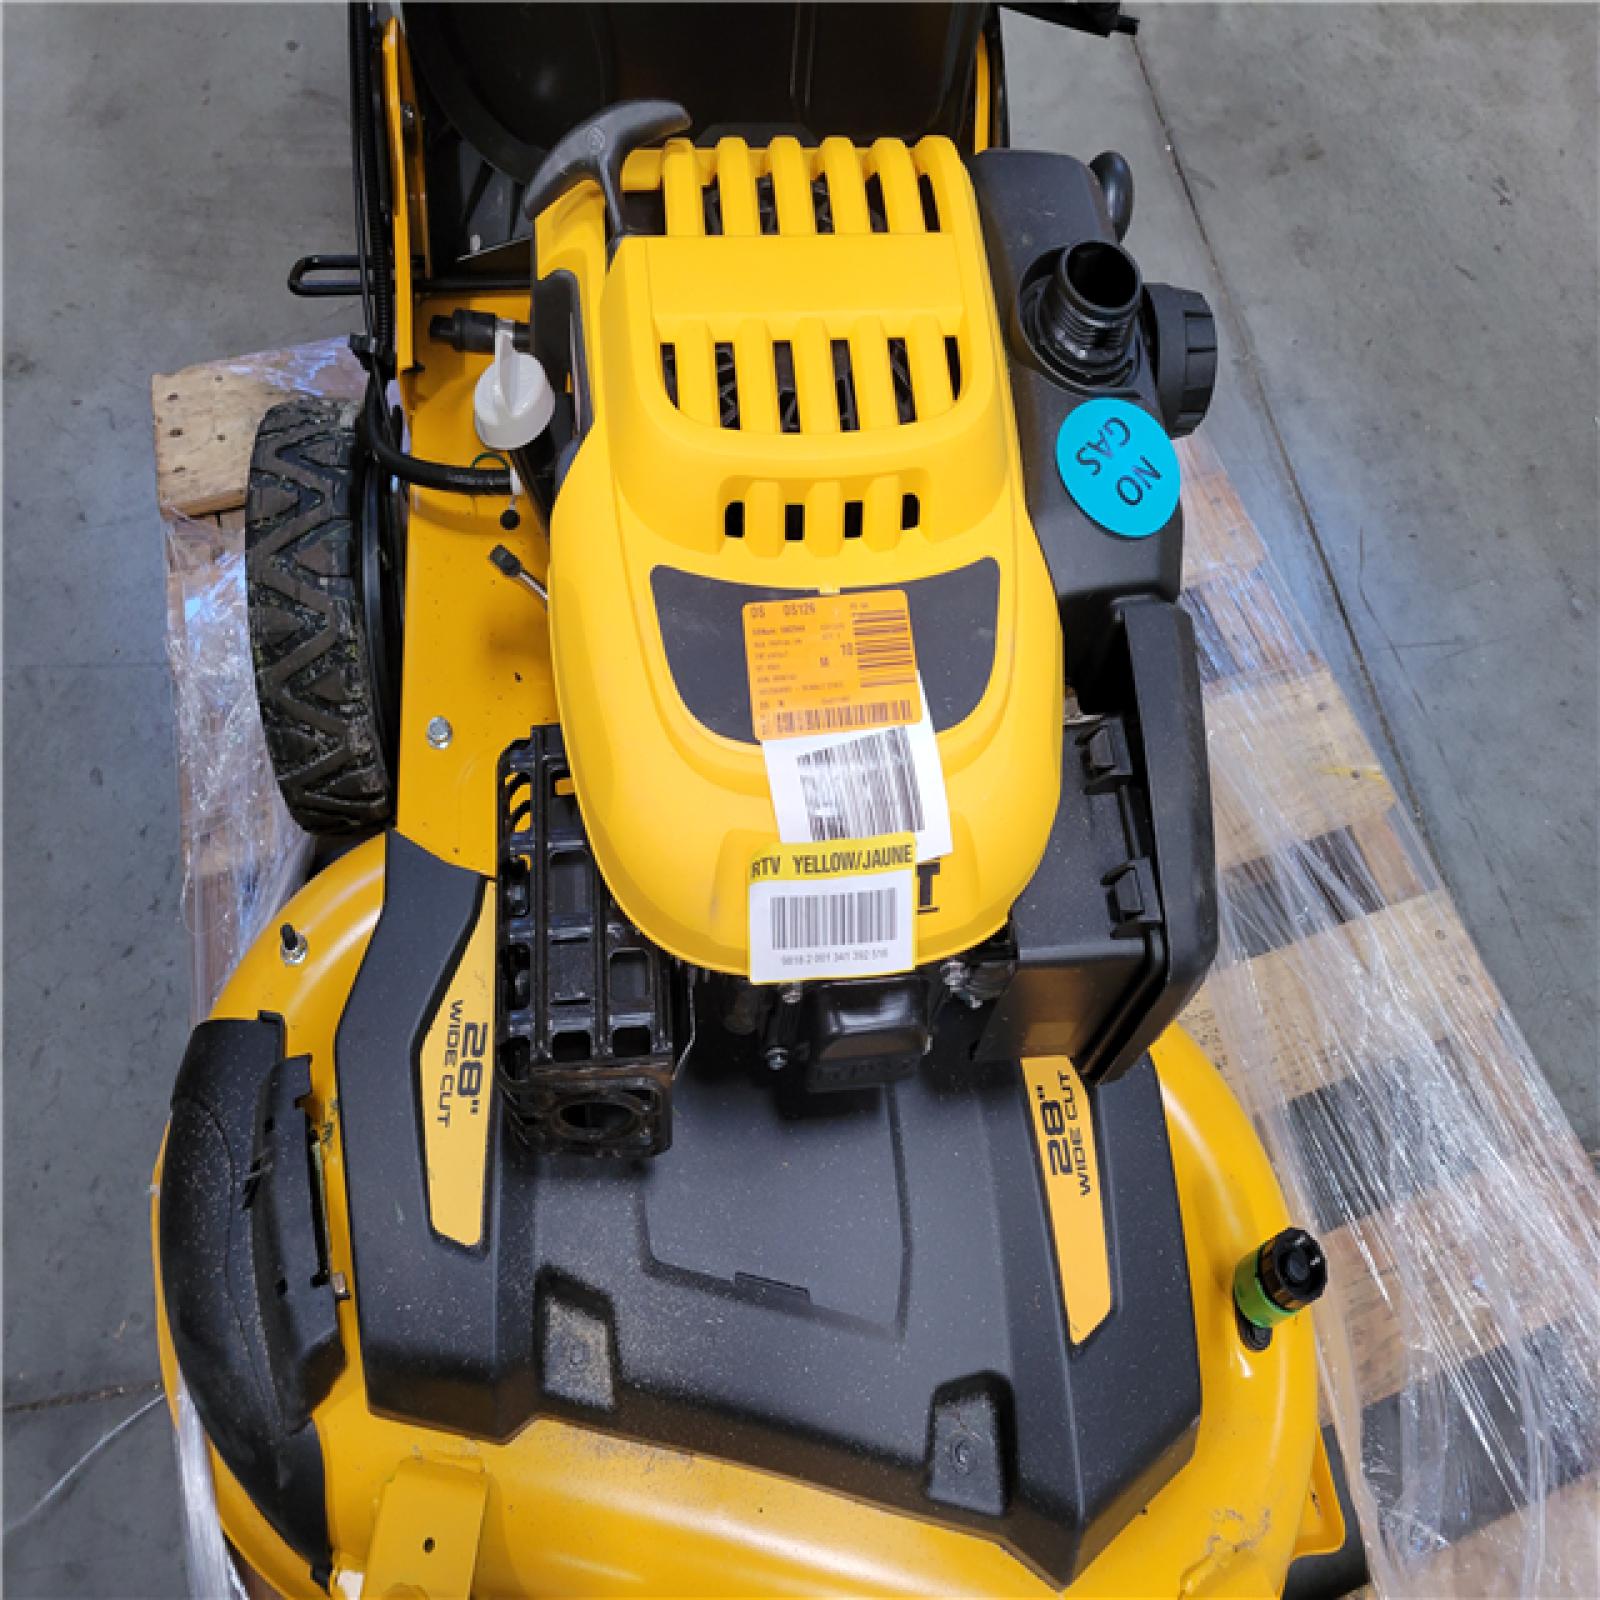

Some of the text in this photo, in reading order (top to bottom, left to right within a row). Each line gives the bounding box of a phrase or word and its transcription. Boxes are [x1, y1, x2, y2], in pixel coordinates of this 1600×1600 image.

[1075, 416, 1131, 476] GAS
[1116, 454, 1162, 506] NO
[751, 843, 914, 880] RTV YELLOW/JAUNE
[437, 999, 463, 1128] WIDE CUT
[457, 1021, 489, 1115] 28"
[1035, 1084, 1074, 1176] 28"
[1056, 1069, 1091, 1197] WIDE CUT
